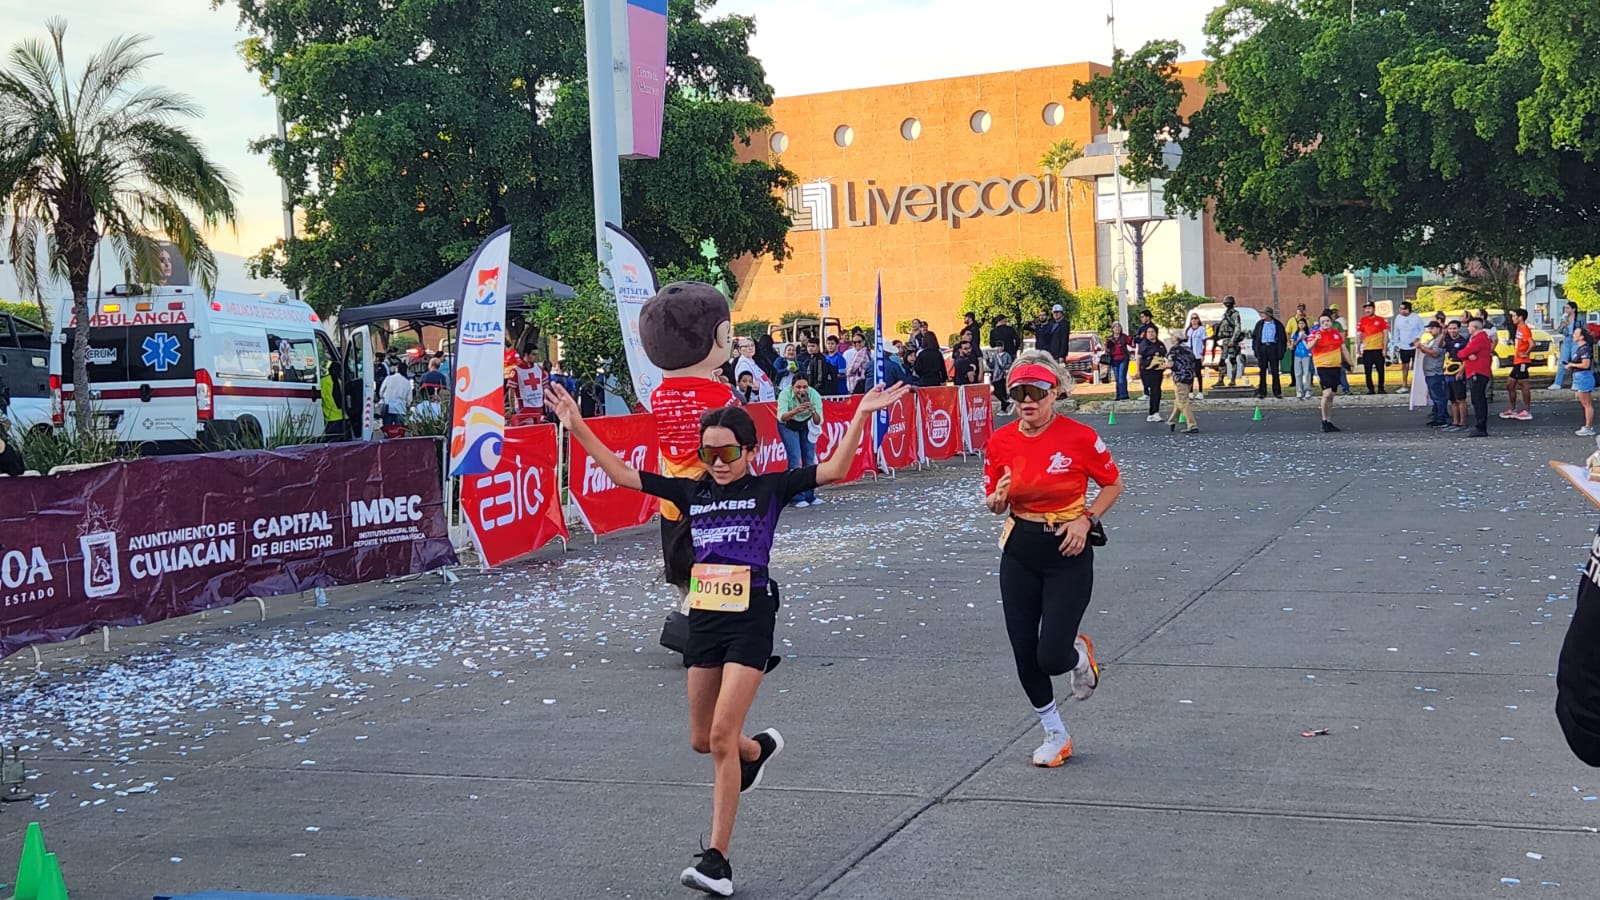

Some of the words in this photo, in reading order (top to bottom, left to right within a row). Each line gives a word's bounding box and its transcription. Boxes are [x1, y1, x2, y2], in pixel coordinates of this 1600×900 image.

[843, 171, 1055, 229] Liverpool
[420, 299, 456, 310] POWER
[350, 494, 424, 528] IMDEC
[689, 498, 756, 516] BREAKERS
[128, 523, 216, 551] AYUNTAMIENTO
[217, 521, 236, 536] DE
[252, 510, 333, 540] CAPITAL
[129, 538, 236, 580] CULIACÁN
[251, 542, 268, 558] DE
[270, 534, 333, 555] BIENESTAR
[0, 546, 53, 588] OA
[5, 587, 55, 607] ESTADO
[697, 579, 744, 597] 00169
